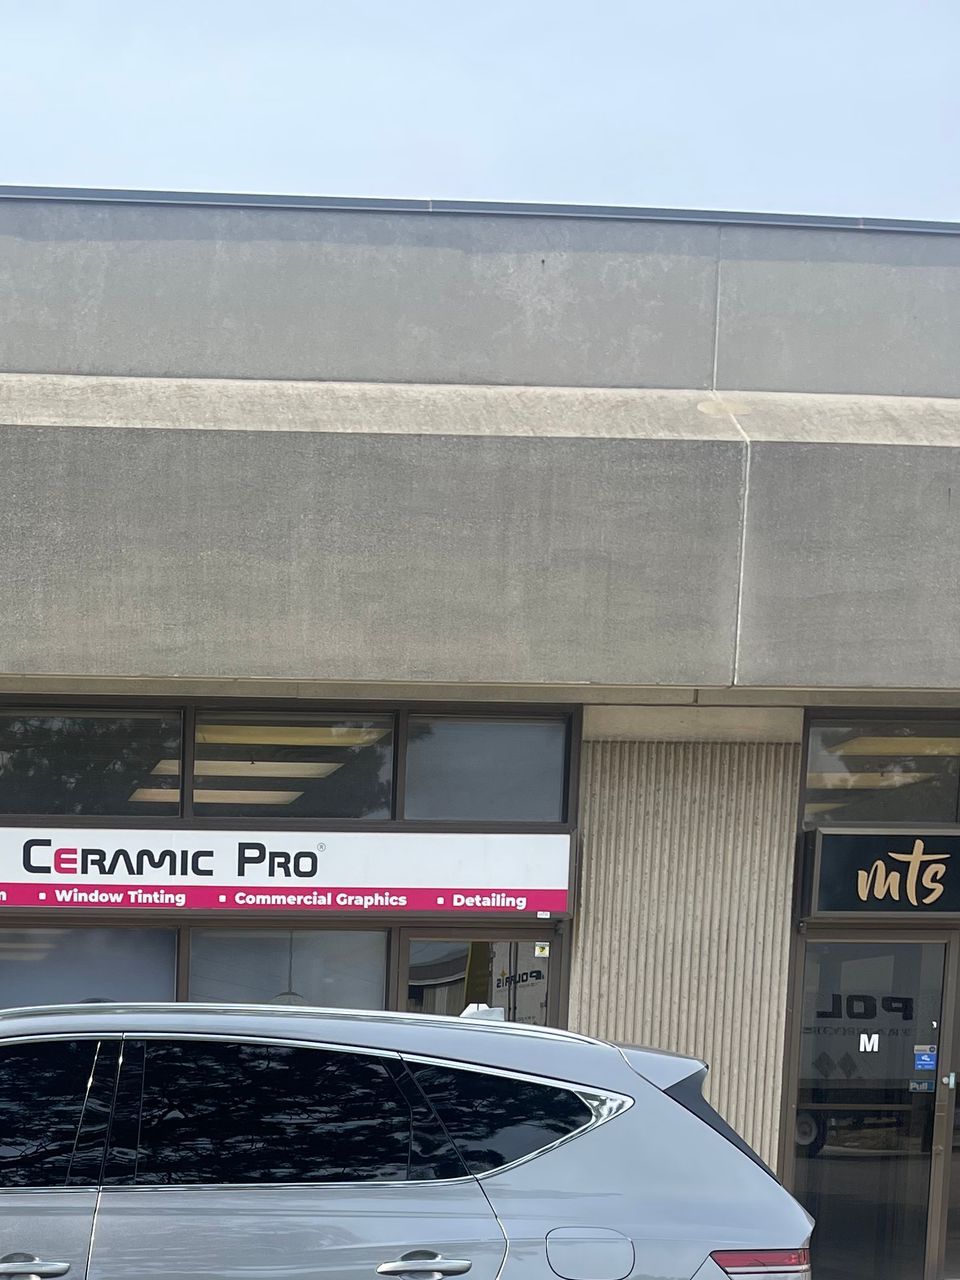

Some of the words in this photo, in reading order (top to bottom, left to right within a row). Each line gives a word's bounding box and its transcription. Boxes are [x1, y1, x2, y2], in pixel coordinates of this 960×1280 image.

[857, 838, 951, 907] mts
[55, 888, 123, 904] Window
[127, 889, 186, 907] Tinting
[234, 891, 332, 907] Commercial
[336, 892, 407, 909] Graphics
[452, 893, 527, 910] Detailing
